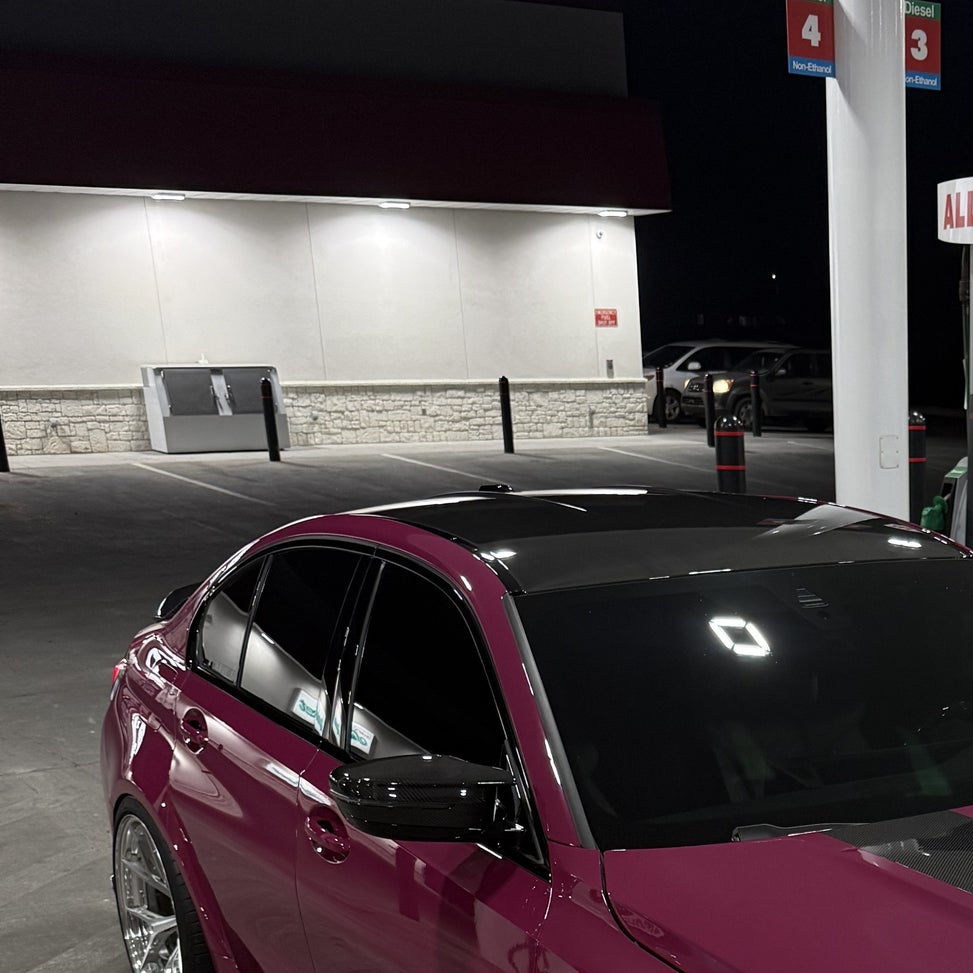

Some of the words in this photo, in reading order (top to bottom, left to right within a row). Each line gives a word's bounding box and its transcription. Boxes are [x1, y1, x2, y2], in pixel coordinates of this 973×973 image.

[905, 1, 935, 18] Diesel
[801, 14, 821, 47] 4
[910, 29, 928, 61] 3
[792, 60, 832, 74] Non-Ethanol
[905, 76, 937, 86] on-Ethanol
